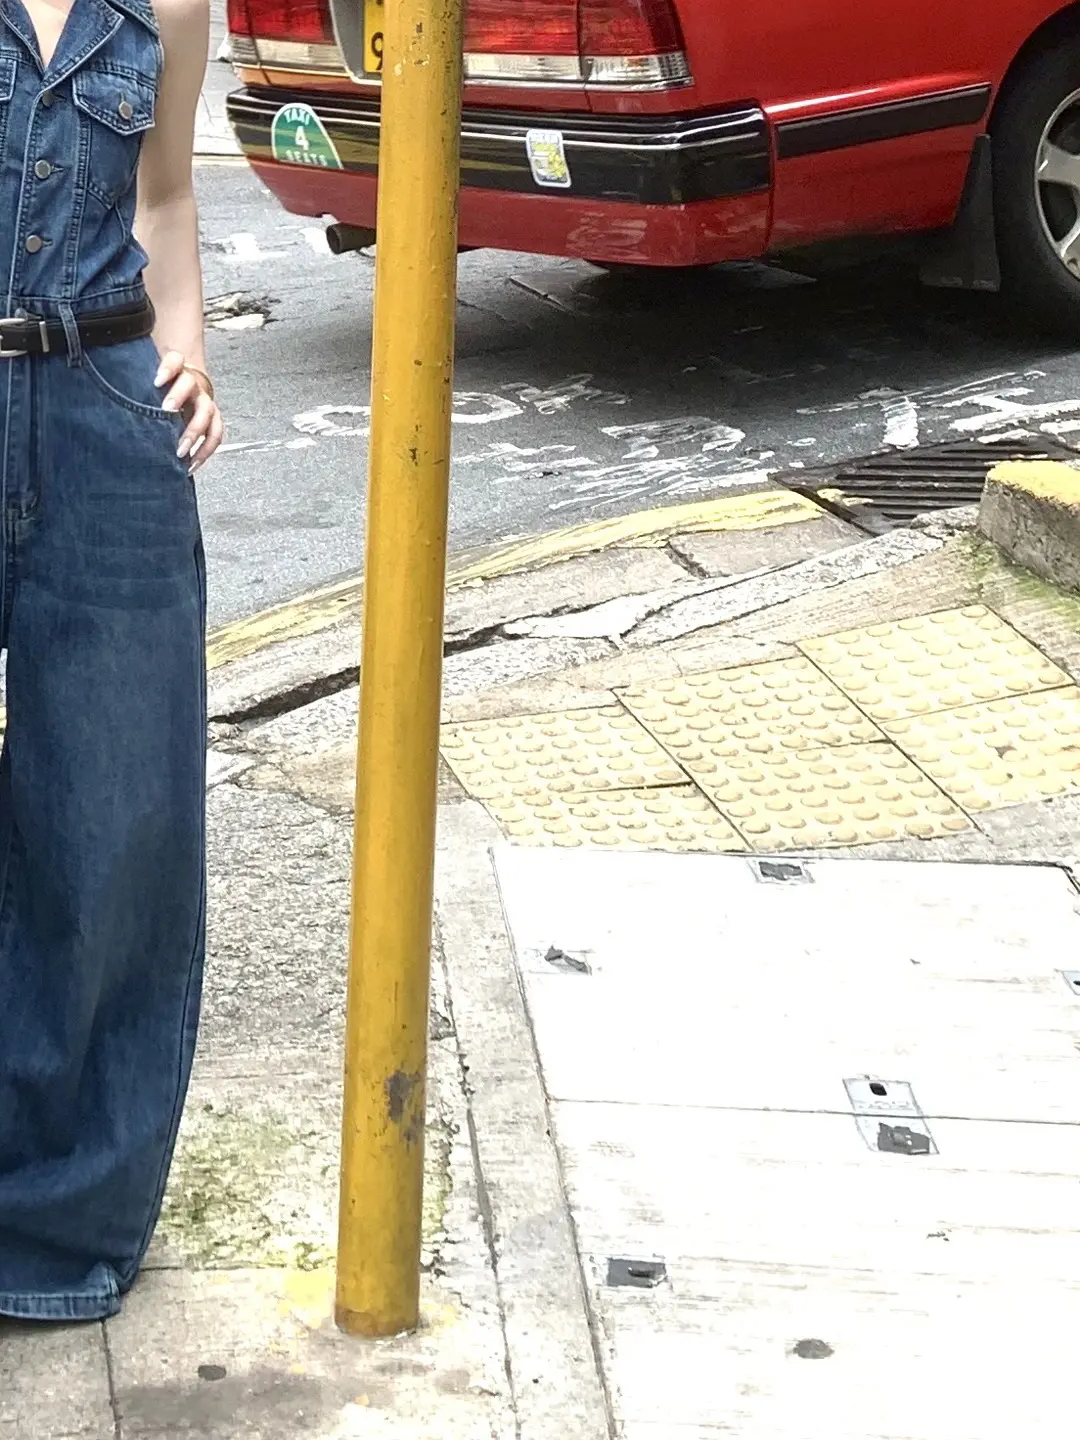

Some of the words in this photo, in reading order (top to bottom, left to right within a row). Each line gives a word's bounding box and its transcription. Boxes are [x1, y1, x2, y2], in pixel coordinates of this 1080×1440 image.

[283, 107, 311, 126] TAXI
[295, 126, 309, 150] 4
[285, 149, 328, 167] SEATS
